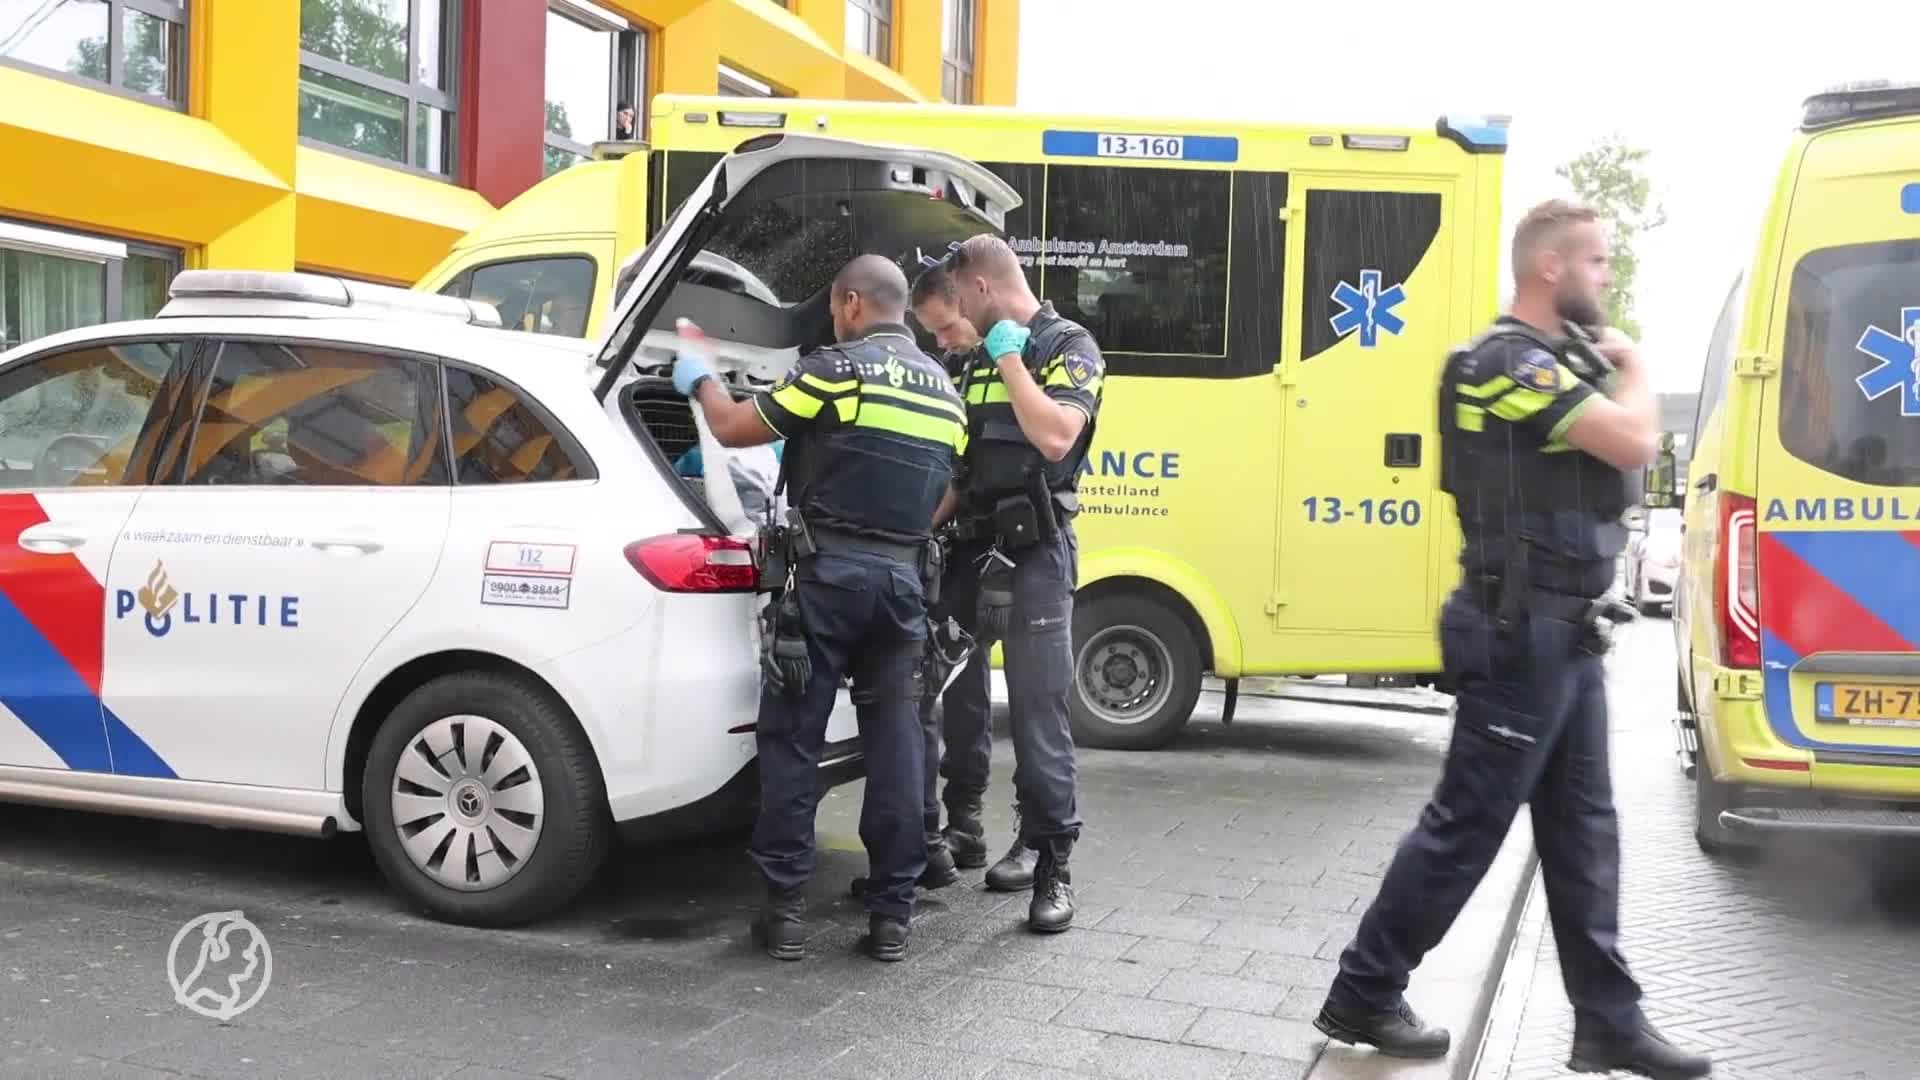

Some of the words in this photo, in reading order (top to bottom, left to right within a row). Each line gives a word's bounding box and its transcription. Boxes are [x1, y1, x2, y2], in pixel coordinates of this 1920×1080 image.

[1102, 136, 1180, 156] 13-160
[1008, 236, 1095, 254] Ambulance
[1098, 239, 1188, 257] Amsterdam
[1078, 503, 1169, 516] Ambulance
[1302, 496, 1421, 526] 13-160
[1764, 497, 1920, 521] AMBUL
[133, 530, 202, 543] waakzaam
[203, 534, 221, 544] en
[222, 532, 293, 547] dienstbaar
[520, 548, 543, 562] 112
[116, 588, 299, 637] POLITIE
[1843, 688, 1920, 715] ZH-7
